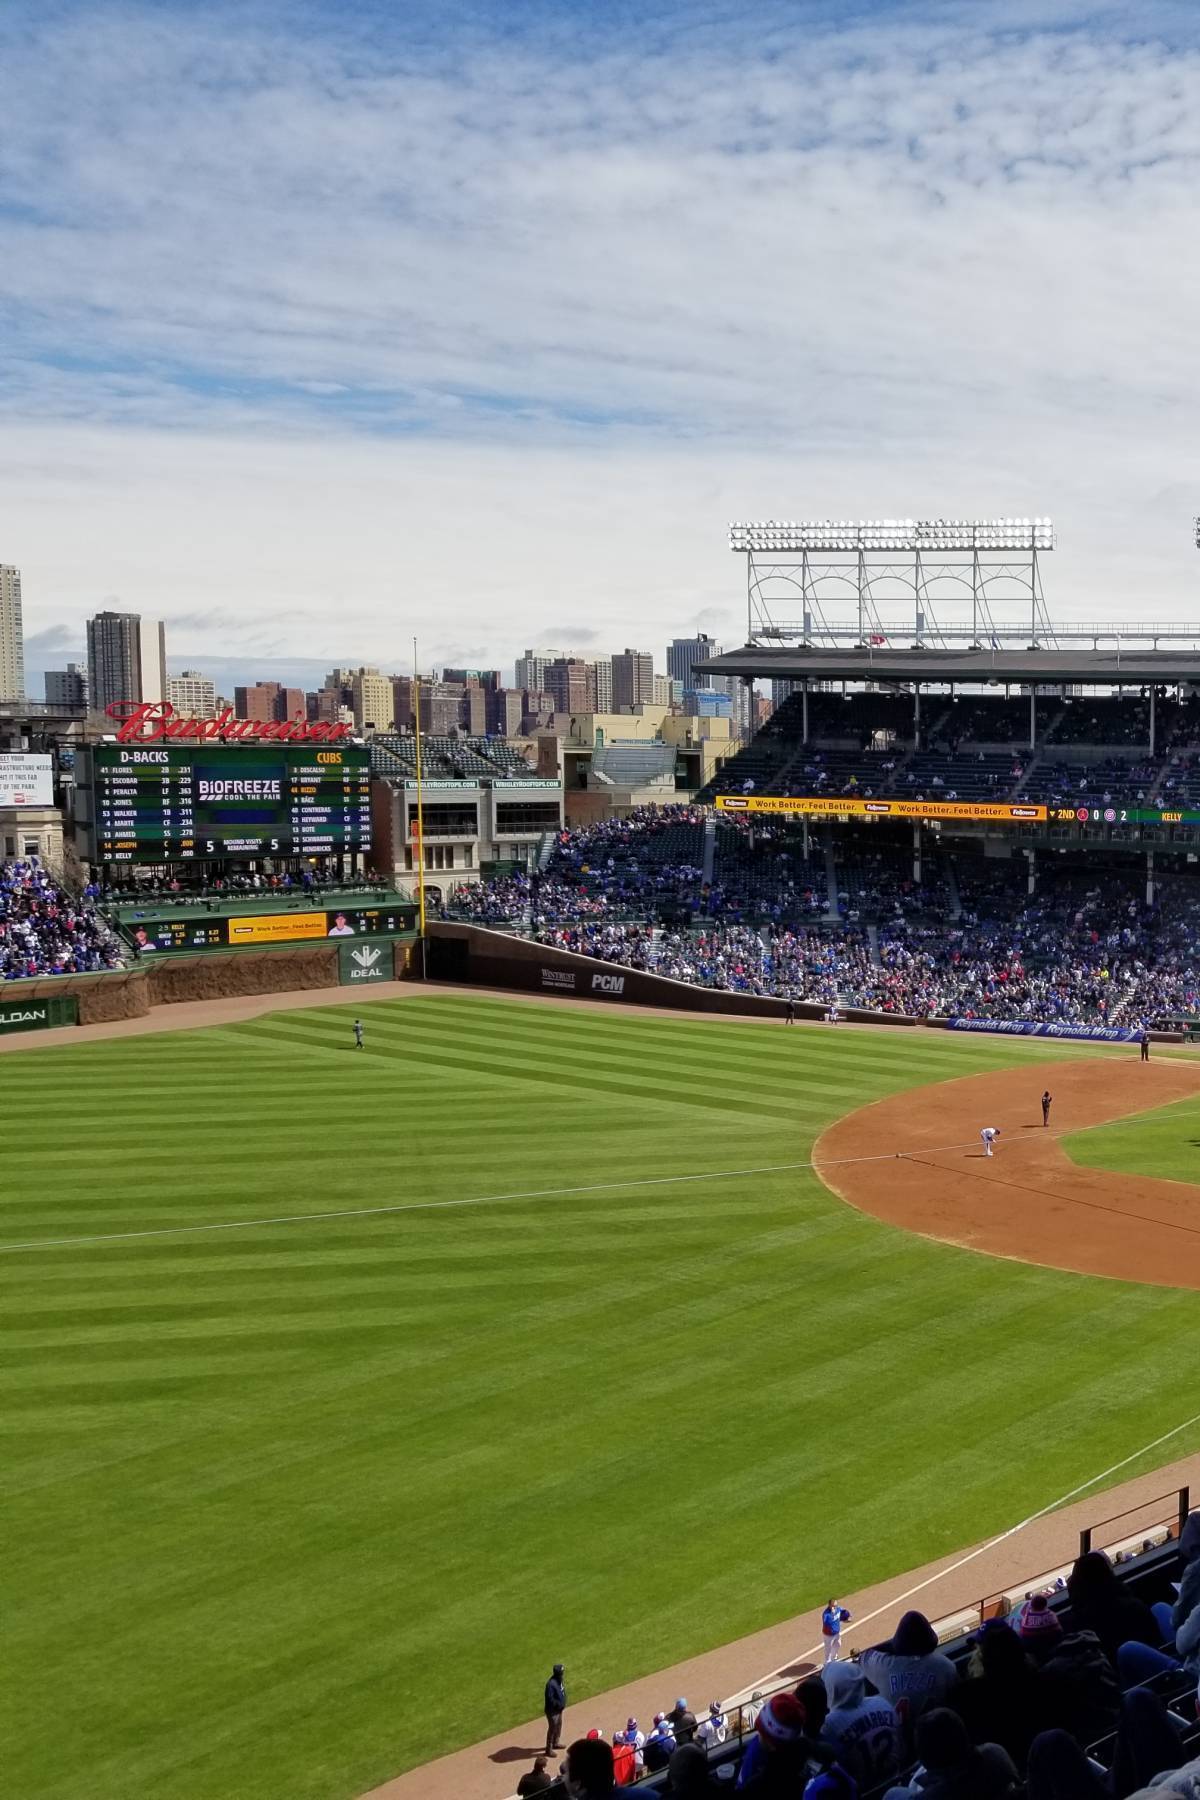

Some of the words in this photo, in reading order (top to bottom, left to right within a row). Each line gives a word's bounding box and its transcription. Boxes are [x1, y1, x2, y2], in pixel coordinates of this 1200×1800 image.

[106, 701, 352, 742] Budweiser
[121, 752, 168, 762] D-BACKS
[316, 753, 342, 763] CUBS
[923, 805, 951, 814] Better.
[1058, 809, 1074, 819] 2ND
[1093, 810, 1099, 820] 0
[1121, 810, 1127, 820] 2
[1162, 813, 1182, 822] KELLY
[206, 841, 214, 852] 5
[271, 839, 278, 850] 5
[351, 968, 382, 977] IDEAL
[592, 974, 624, 990] PCM
[954, 1019, 999, 1029] Reynolds
[999, 1022, 1023, 1032] Wrap
[1046, 1024, 1091, 1035] Reynolds
[1092, 1028, 1118, 1038] Wrap
[890, 1672, 938, 1696] RIZZO
